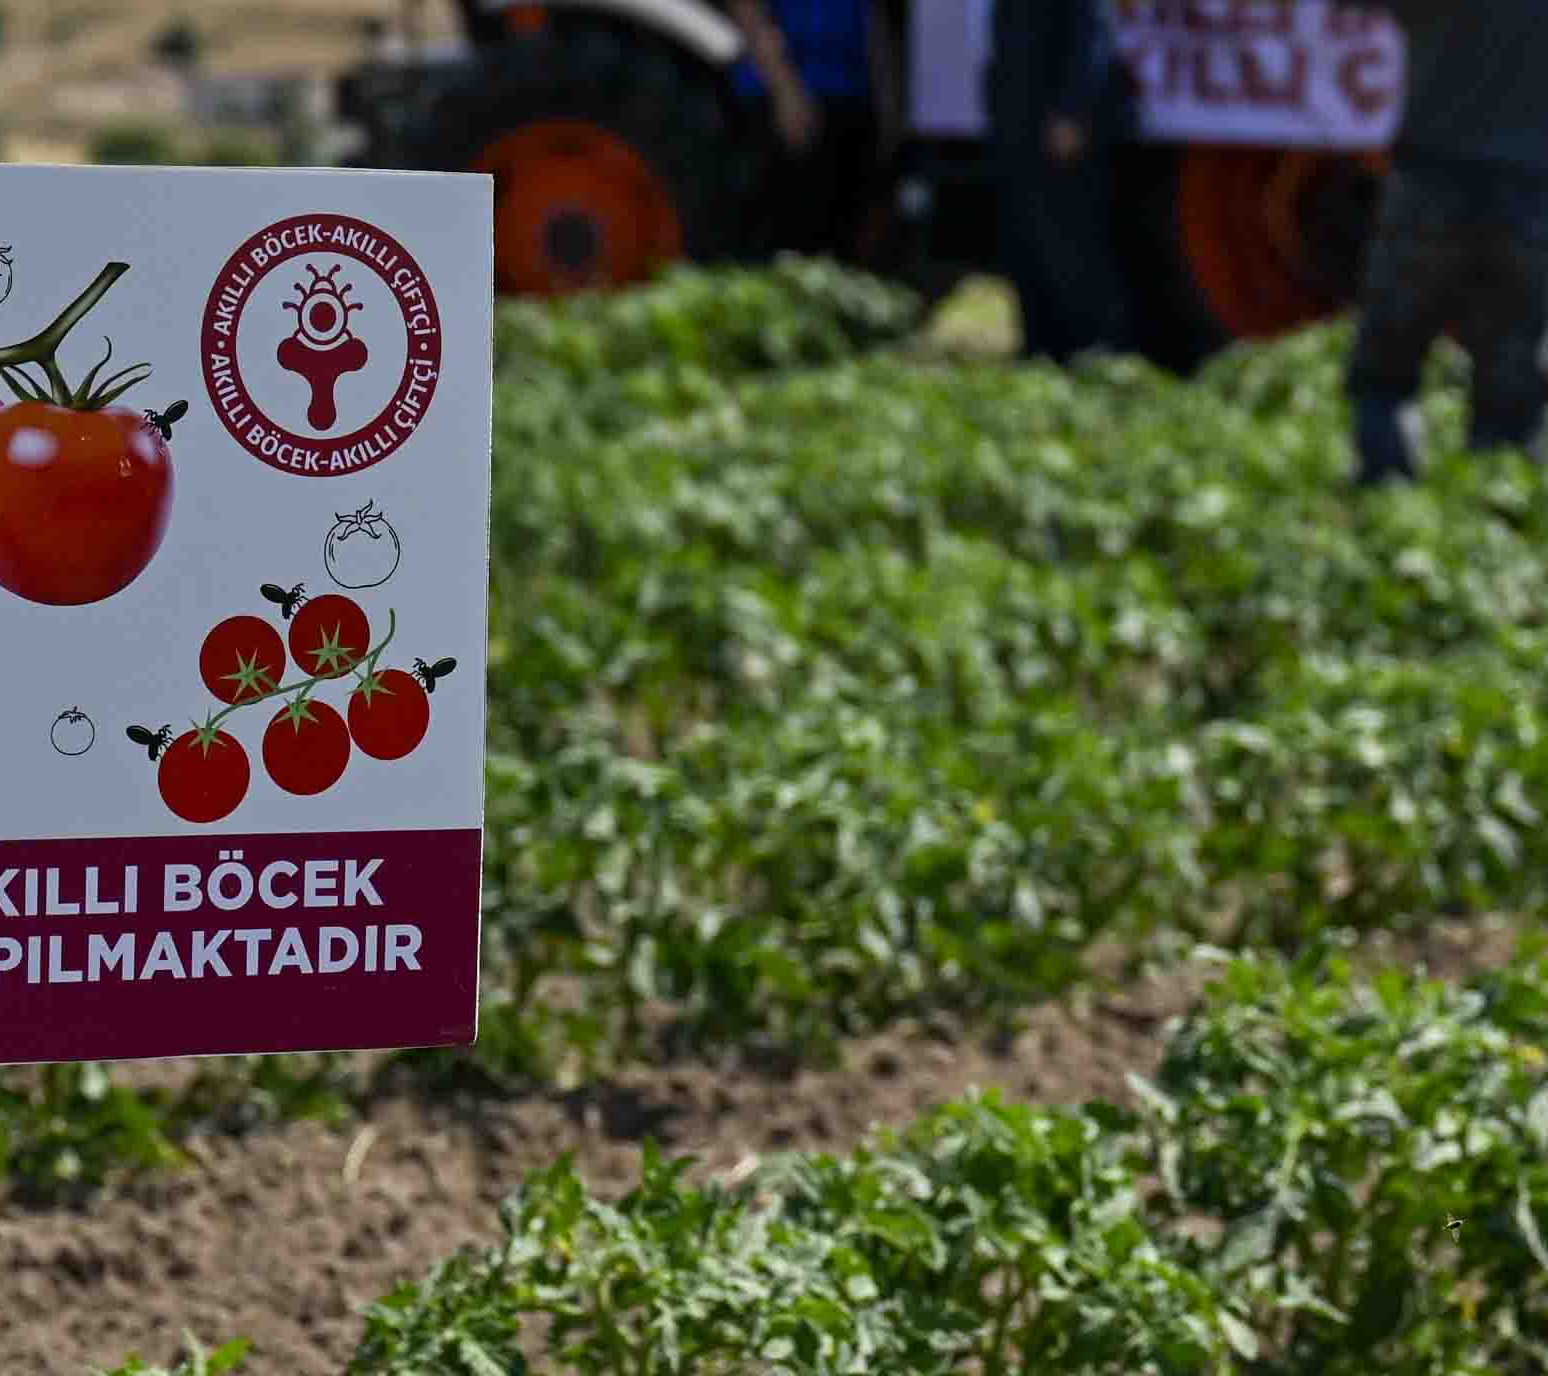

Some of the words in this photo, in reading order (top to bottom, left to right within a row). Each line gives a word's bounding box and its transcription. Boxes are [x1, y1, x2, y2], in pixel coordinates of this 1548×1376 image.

[212, 261, 255, 336] AKILLI
[389, 267, 437, 337] ÇİFTÇİ
[210, 353, 253, 430] AKILLI
[394, 358, 437, 430] ÇİFTÇİ
[162, 849, 386, 913] BÖCEK
